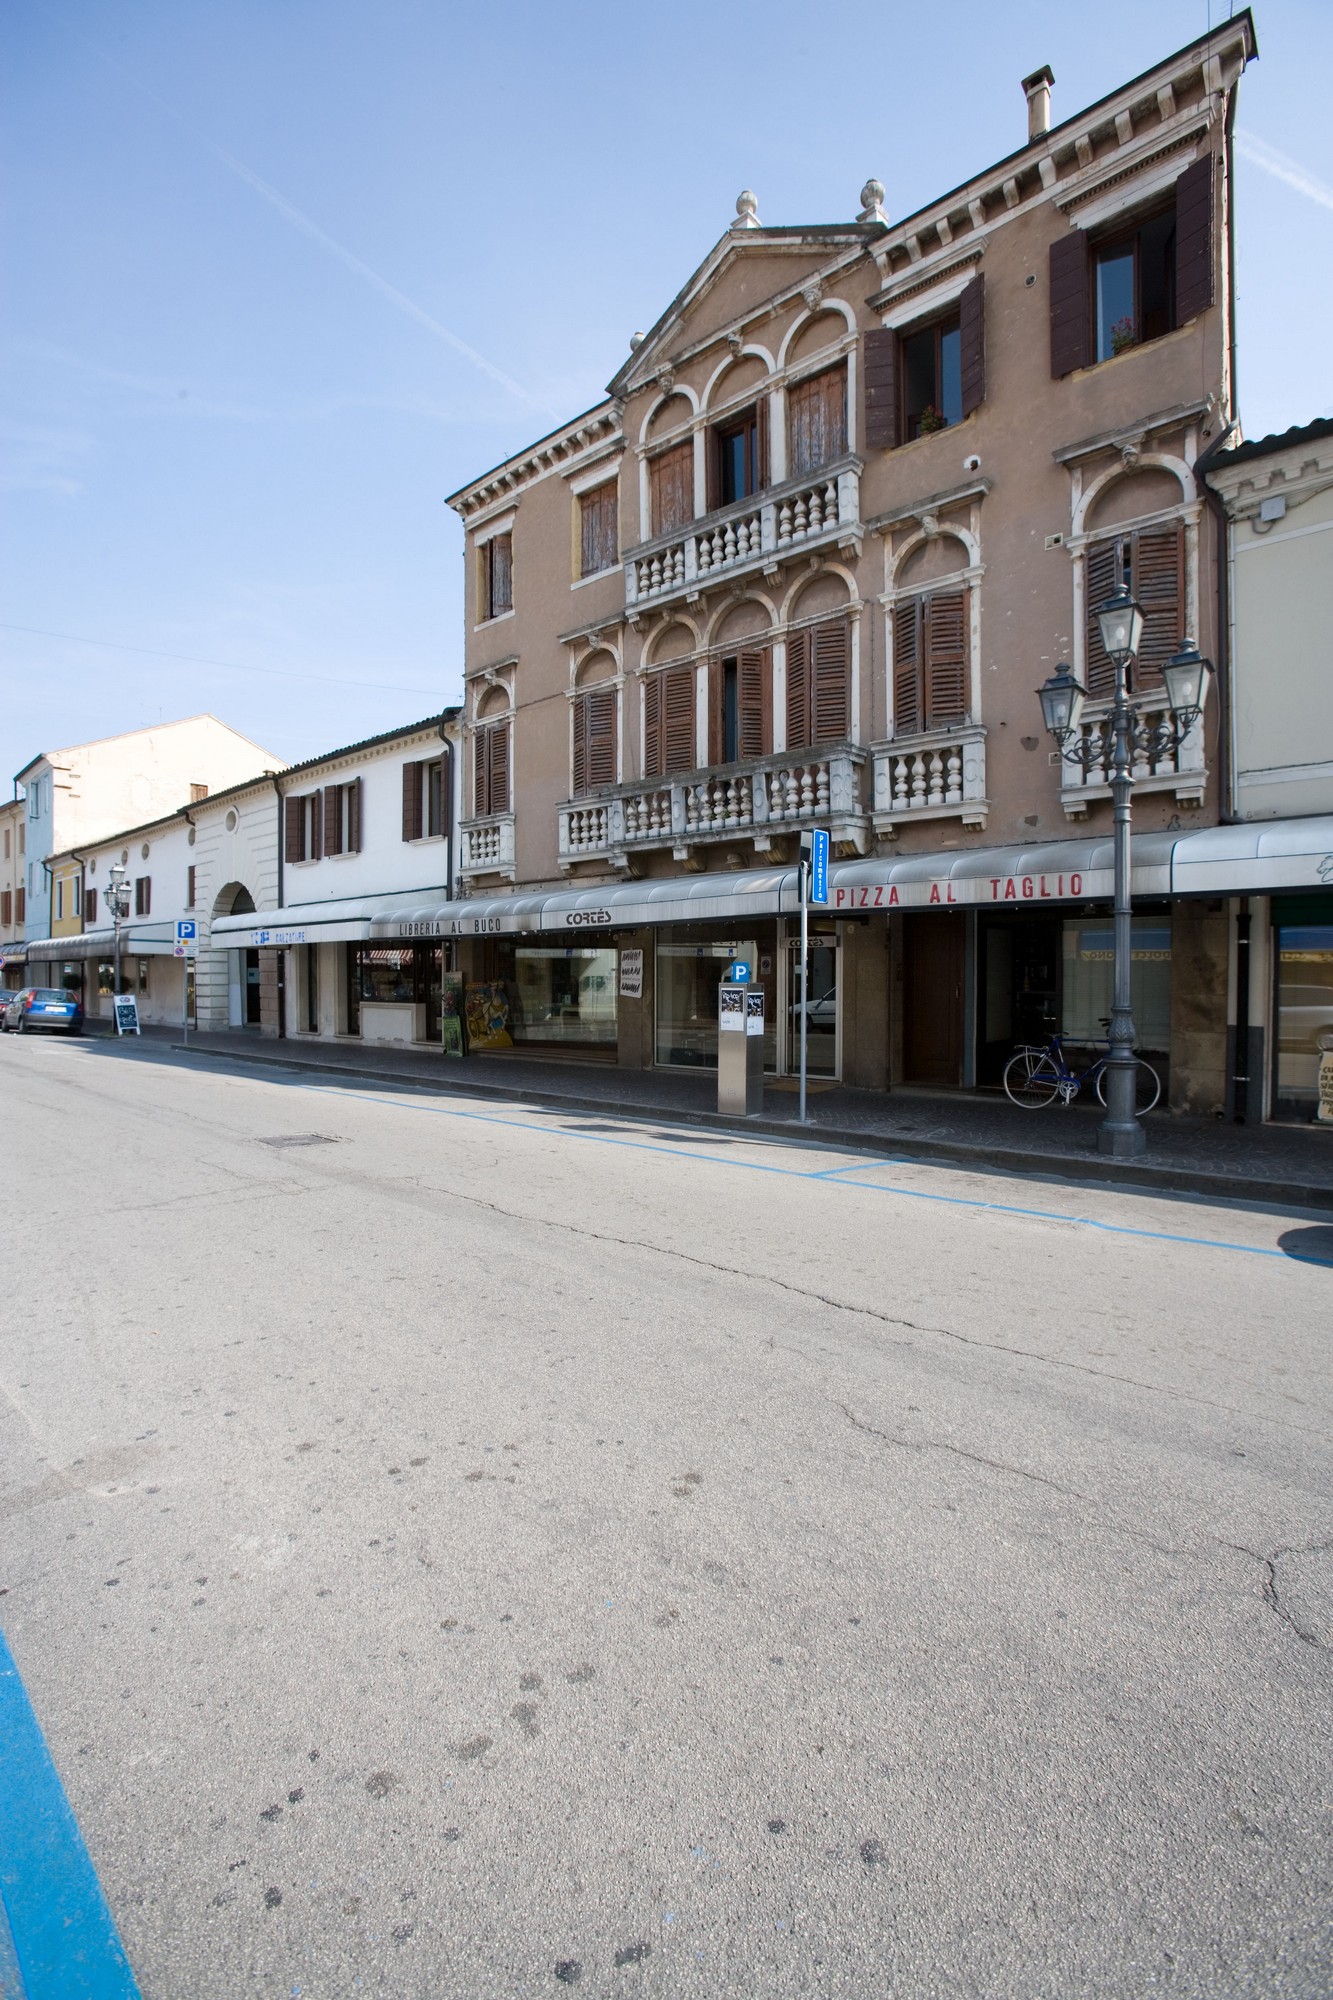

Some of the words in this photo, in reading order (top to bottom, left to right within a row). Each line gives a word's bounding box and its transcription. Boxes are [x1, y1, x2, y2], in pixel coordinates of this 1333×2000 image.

[817, 834, 825, 899] Parcometro
[836, 886, 900, 908] PIZZA
[930, 883, 957, 904] AL
[990, 873, 1082, 900] TAGLIO
[180, 923, 192, 937] P
[399, 921, 441, 936] LIBRERIA
[451, 920, 463, 934] AL
[474, 917, 501, 933] BUCO
[789, 937, 824, 947] COTÉS
[736, 966, 747, 980] P
